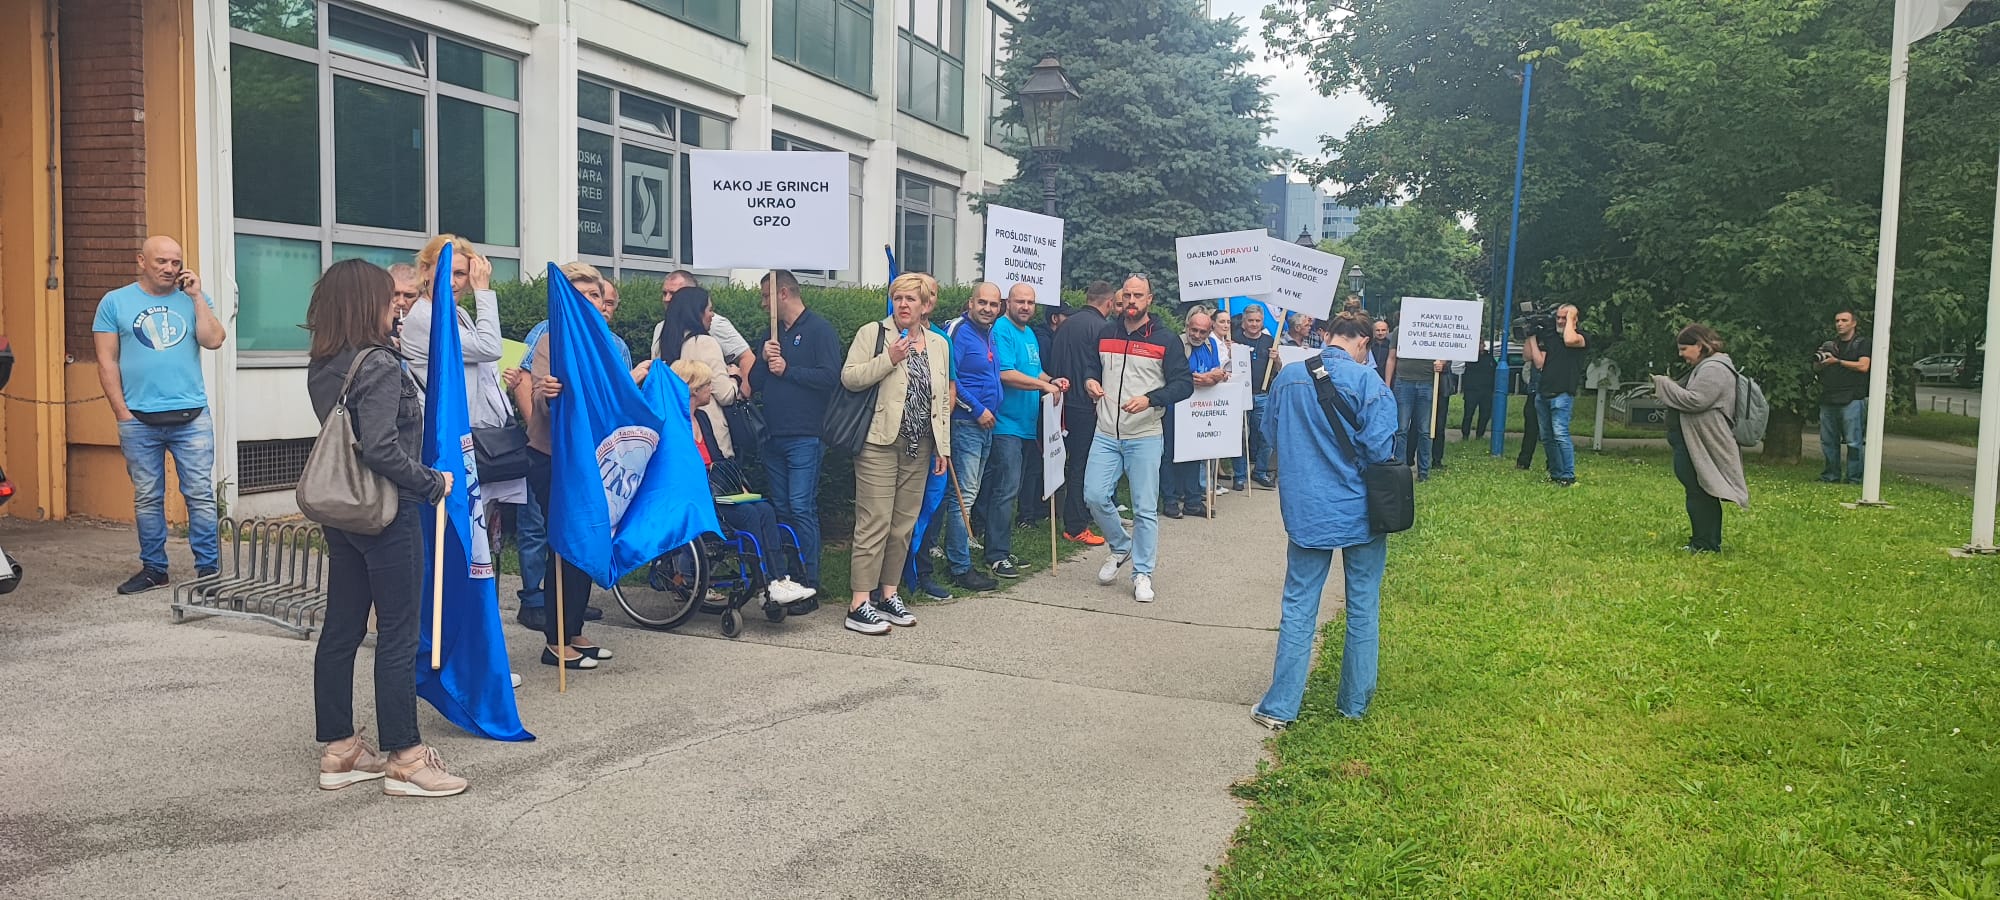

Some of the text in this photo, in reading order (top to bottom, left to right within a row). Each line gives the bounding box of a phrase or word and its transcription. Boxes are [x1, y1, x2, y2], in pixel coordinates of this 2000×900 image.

[713, 180, 829, 192] KAKO JE GRINCH
[578, 185, 603, 200] REB
[747, 197, 796, 209] UKRAO
[753, 215, 791, 226] GPZO
[995, 229, 1057, 248] PROŠLOST VAS NE
[1012, 245, 1040, 258] ZANIMA,
[1220, 246, 1252, 256] UPRAVU
[1271, 264, 1291, 275] ZRNO
[1005, 271, 1044, 285] JOŠ MANJE
[1188, 274, 1262, 287] SAVJETNICI GRATIS
[1292, 291, 1303, 299] NE
[1438, 341, 1467, 349] IZGUBILI
[1190, 399, 1229, 408] UPRAVA UŽIVA
[1191, 409, 1228, 417] POVJERENJE,
